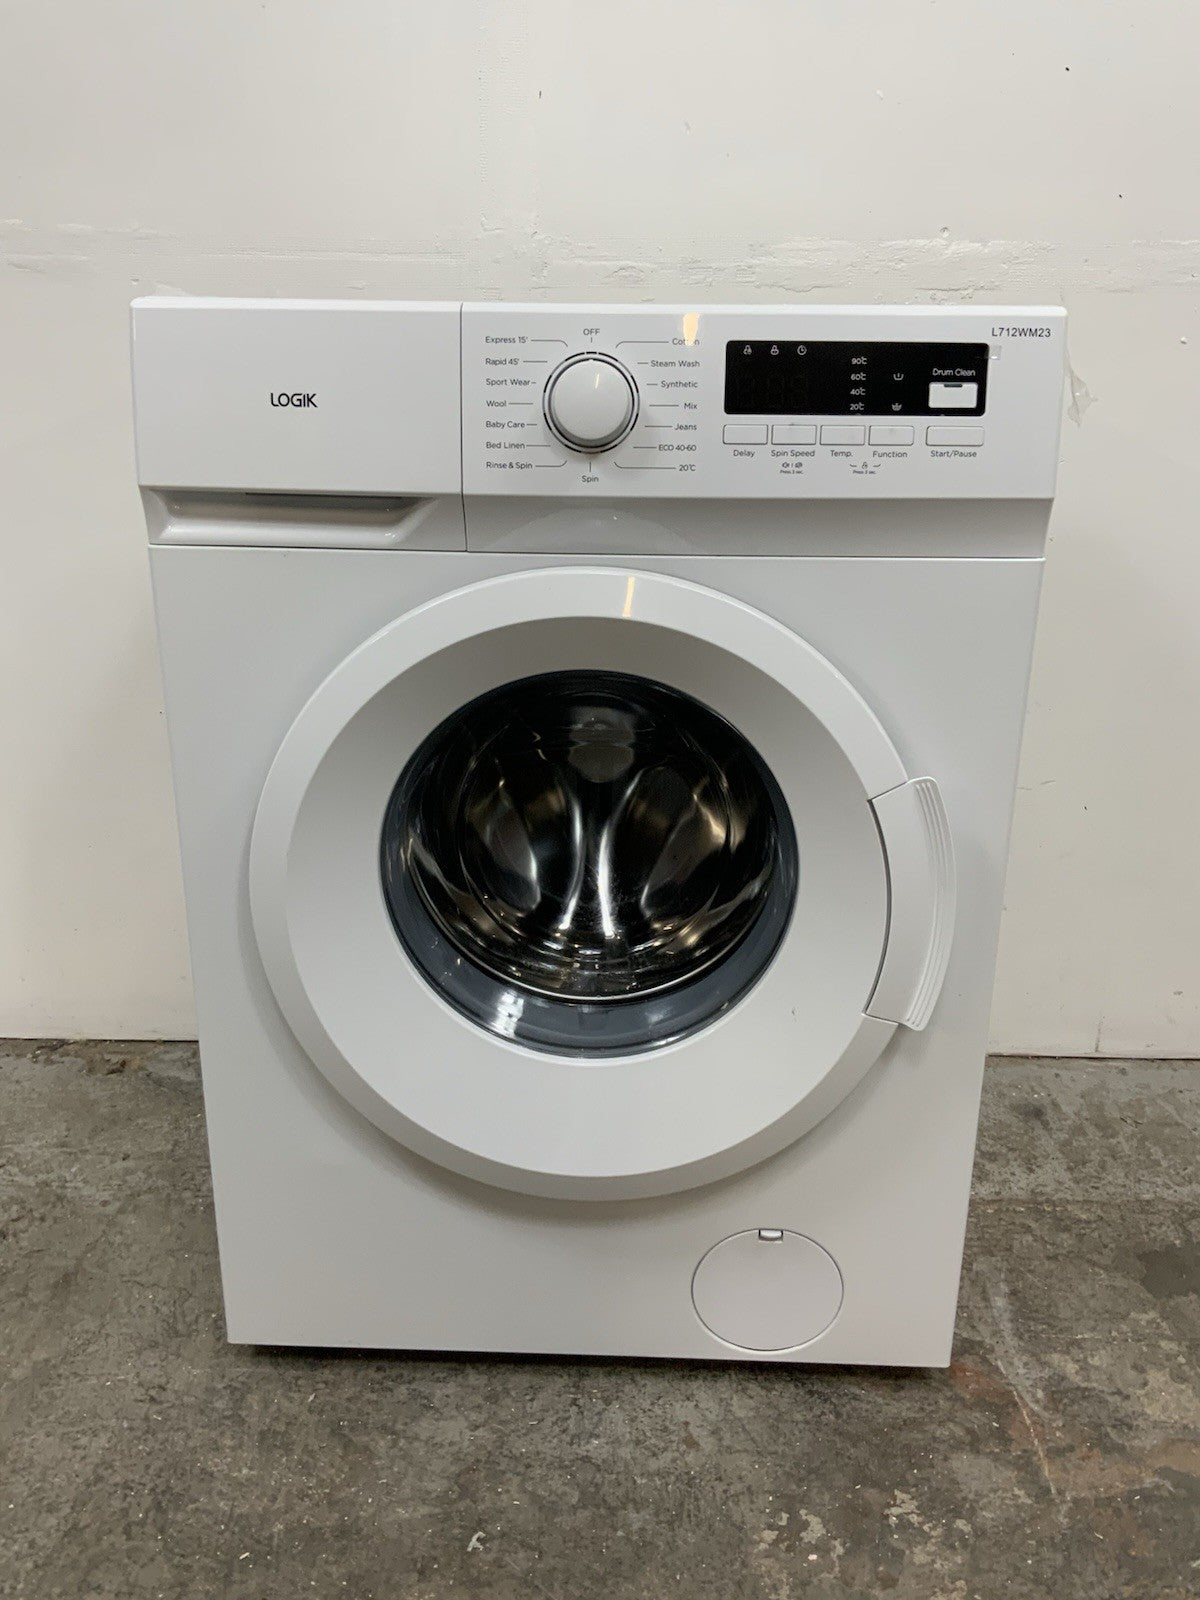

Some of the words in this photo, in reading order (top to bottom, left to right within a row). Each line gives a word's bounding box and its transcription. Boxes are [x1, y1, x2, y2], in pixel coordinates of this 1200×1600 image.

[992, 328, 1051, 337] L712WM23
[933, 368, 953, 377] Drum
[955, 368, 975, 377] Clean
[486, 379, 507, 387] Sport
[661, 381, 698, 389] Synthetic
[271, 392, 318, 408] LOGIK
[486, 421, 505, 429] Baby
[733, 449, 755, 458] Delay
[771, 449, 788, 458] Spin
[791, 449, 815, 458] Speed
[830, 450, 853, 458] Temp.
[873, 450, 907, 458] Function
[930, 450, 977, 458] Start/Pause
[515, 462, 532, 470] Spin
[582, 475, 599, 483] Spin
